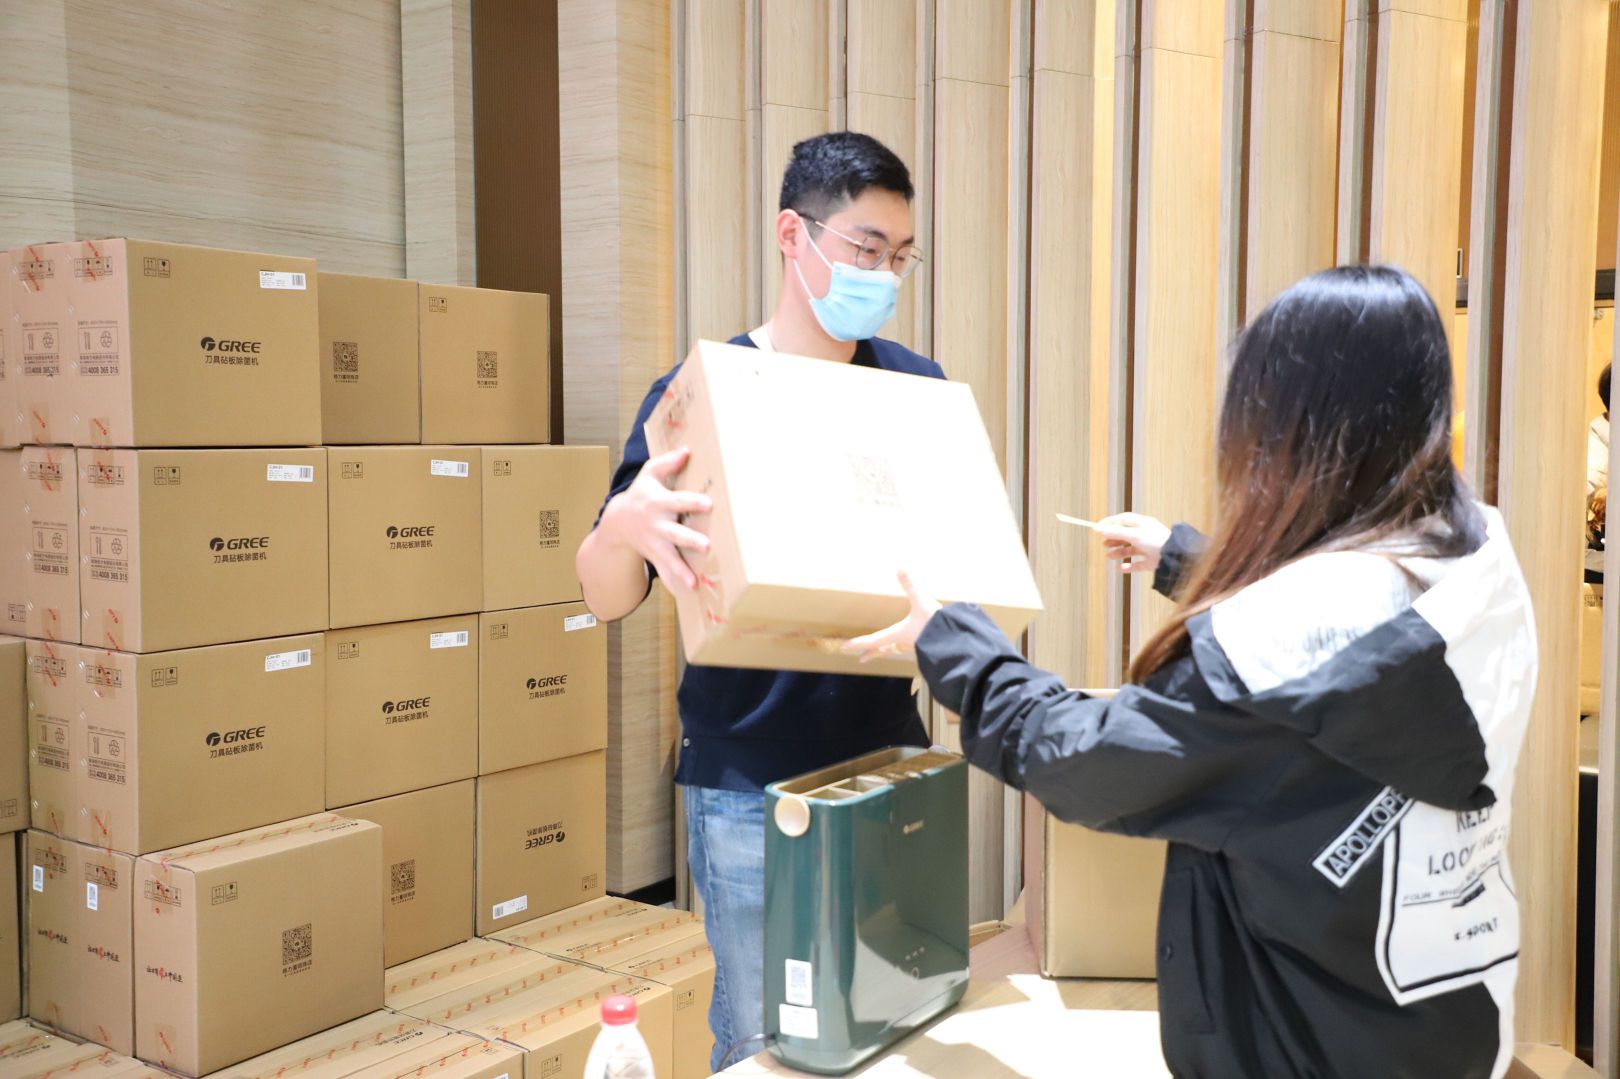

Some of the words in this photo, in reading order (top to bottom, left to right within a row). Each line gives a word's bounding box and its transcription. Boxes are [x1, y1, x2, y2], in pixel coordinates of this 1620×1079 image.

[218, 340, 262, 353] GREE
[204, 355, 259, 366] 刀具砧板除菌机
[400, 525, 435, 538] GREE
[227, 536, 270, 550] GREE
[213, 551, 267, 564] 刀具砧板除菌机
[537, 674, 568, 688] GREE
[396, 696, 431, 712] GREE
[385, 710, 429, 725] 刀具砧板除菌机
[223, 725, 267, 743] GREE
[209, 741, 264, 759] 刀具砧板除菌机
[524, 833, 554, 850] GREE
